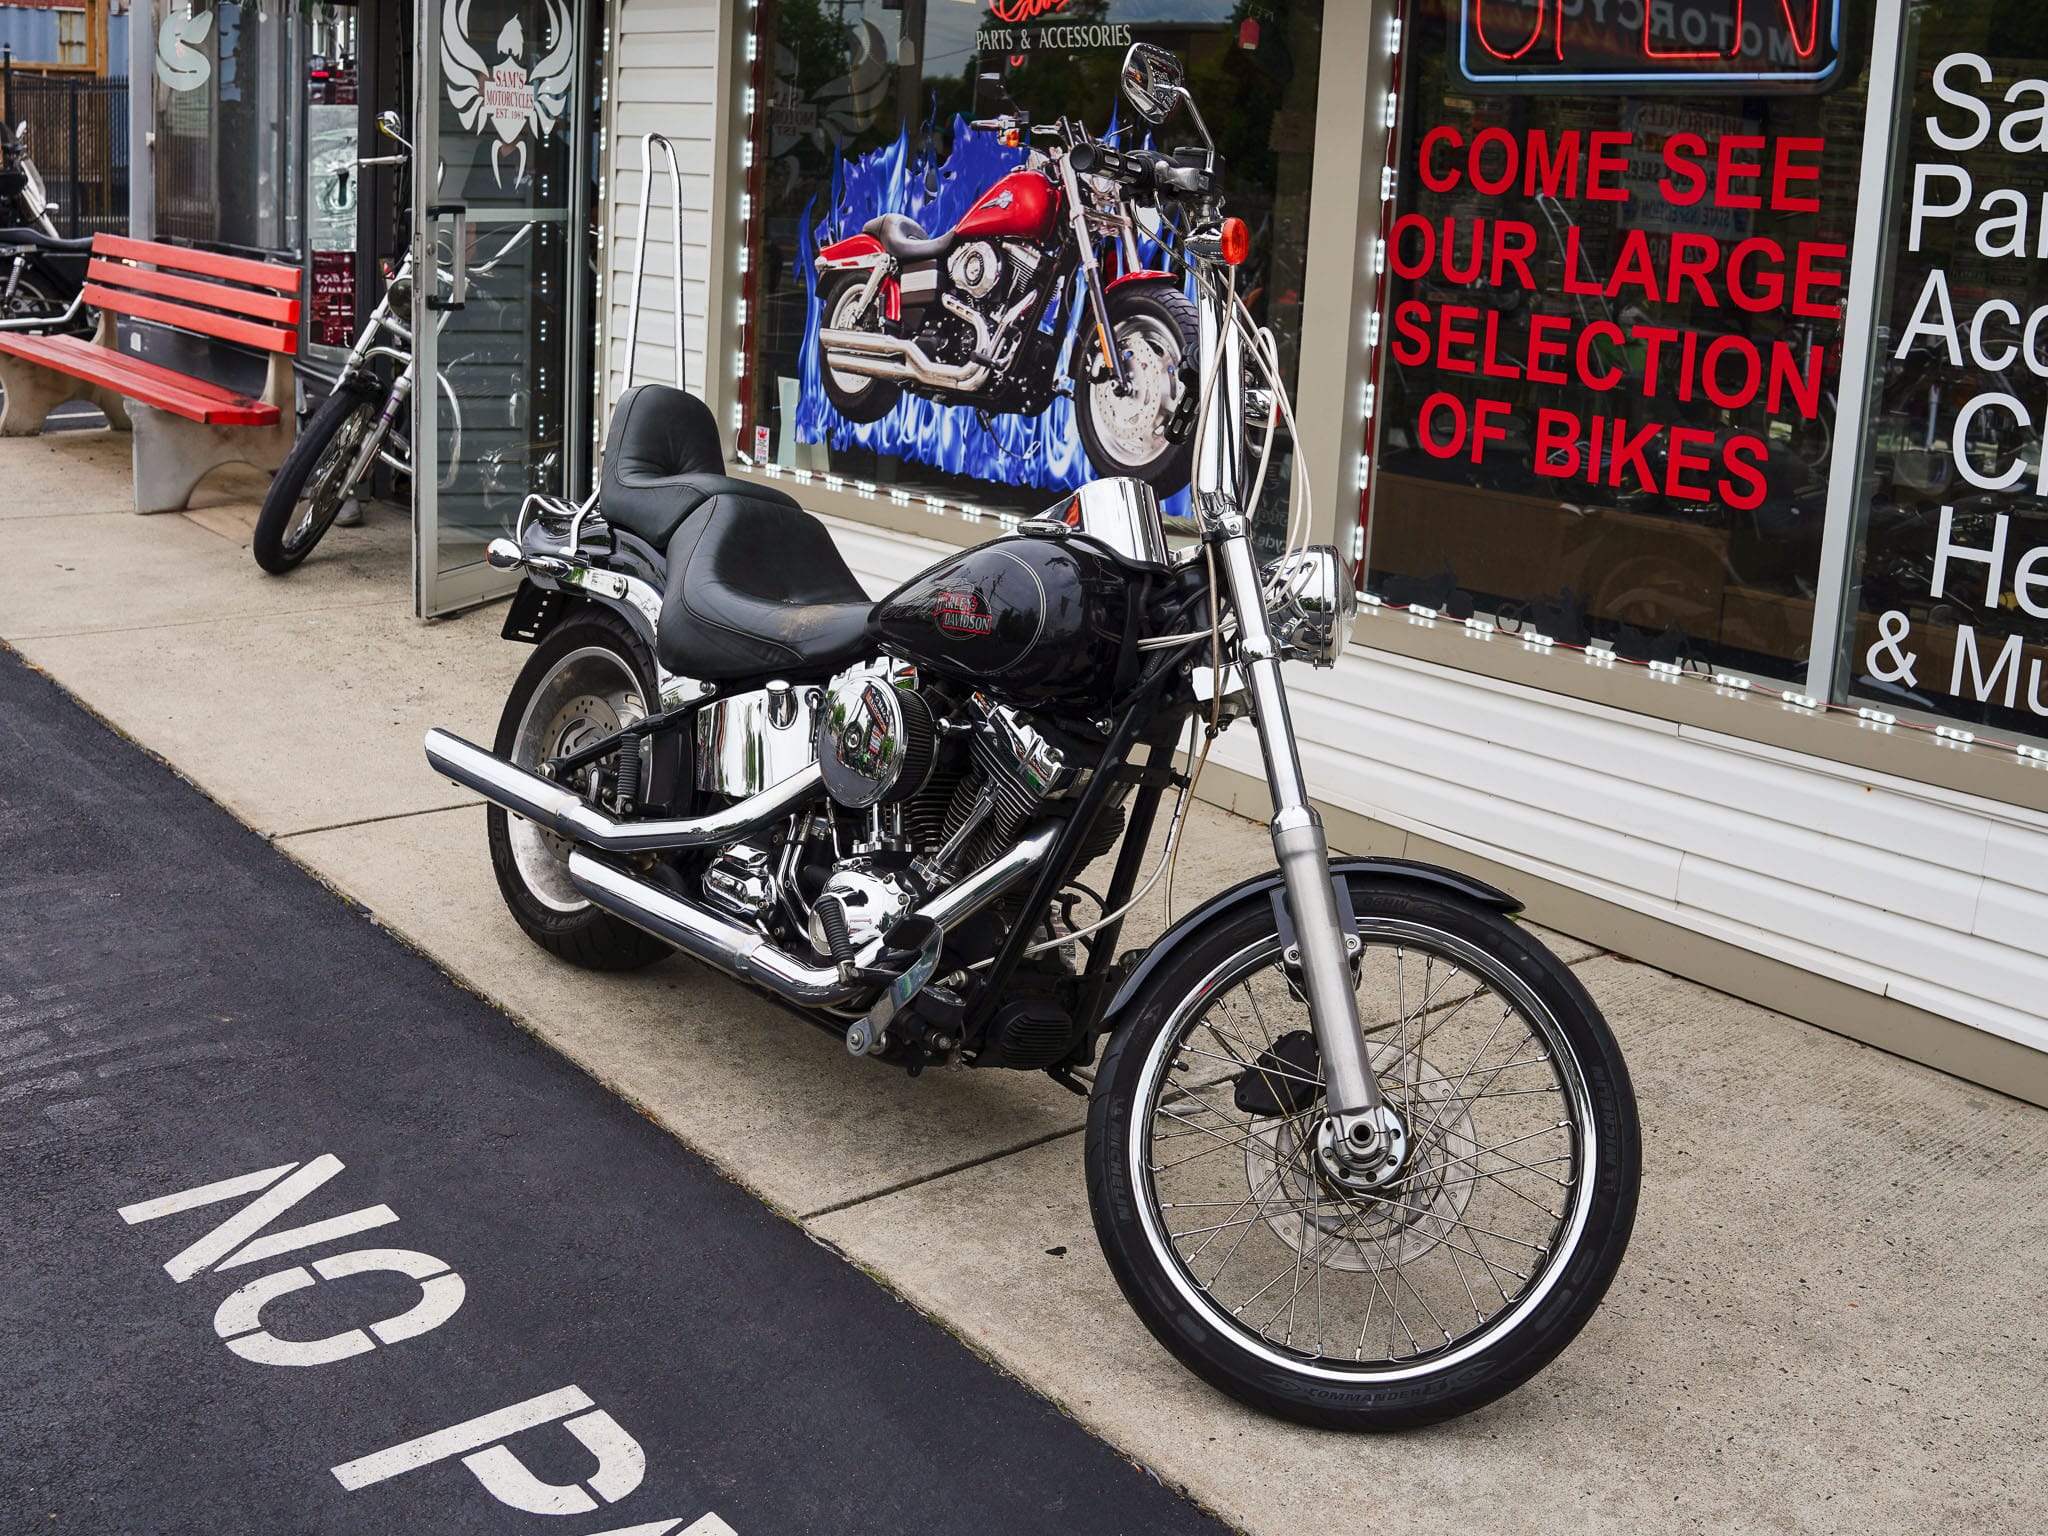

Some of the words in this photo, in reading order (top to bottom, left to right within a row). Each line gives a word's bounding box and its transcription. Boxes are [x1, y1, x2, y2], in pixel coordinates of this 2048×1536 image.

[495, 70, 526, 89] SAM'S
[976, 29, 1013, 50] PARTS
[1020, 29, 1032, 49] &
[1039, 24, 1132, 48] ACCESSORIES
[486, 89, 534, 109] MOTORCYCLES
[1420, 126, 1633, 202] COME
[1659, 132, 1825, 212] SEE
[1387, 214, 1537, 290] OUR
[1564, 226, 1847, 319] LARGE
[1391, 301, 1824, 419] SELECTION
[1419, 393, 1512, 464] OF
[1533, 408, 1769, 510] BIKES
[1930, 505, 2048, 621] He
[944, 613, 990, 631] DAVIDSON
[1866, 610, 1918, 688] &
[1593, 1066, 1618, 1163] MICHELIN
[1110, 1121, 1134, 1225] MICHELIN
[117, 1153, 467, 1367] NO
[1307, 1386, 1423, 1402] COMMANDER
